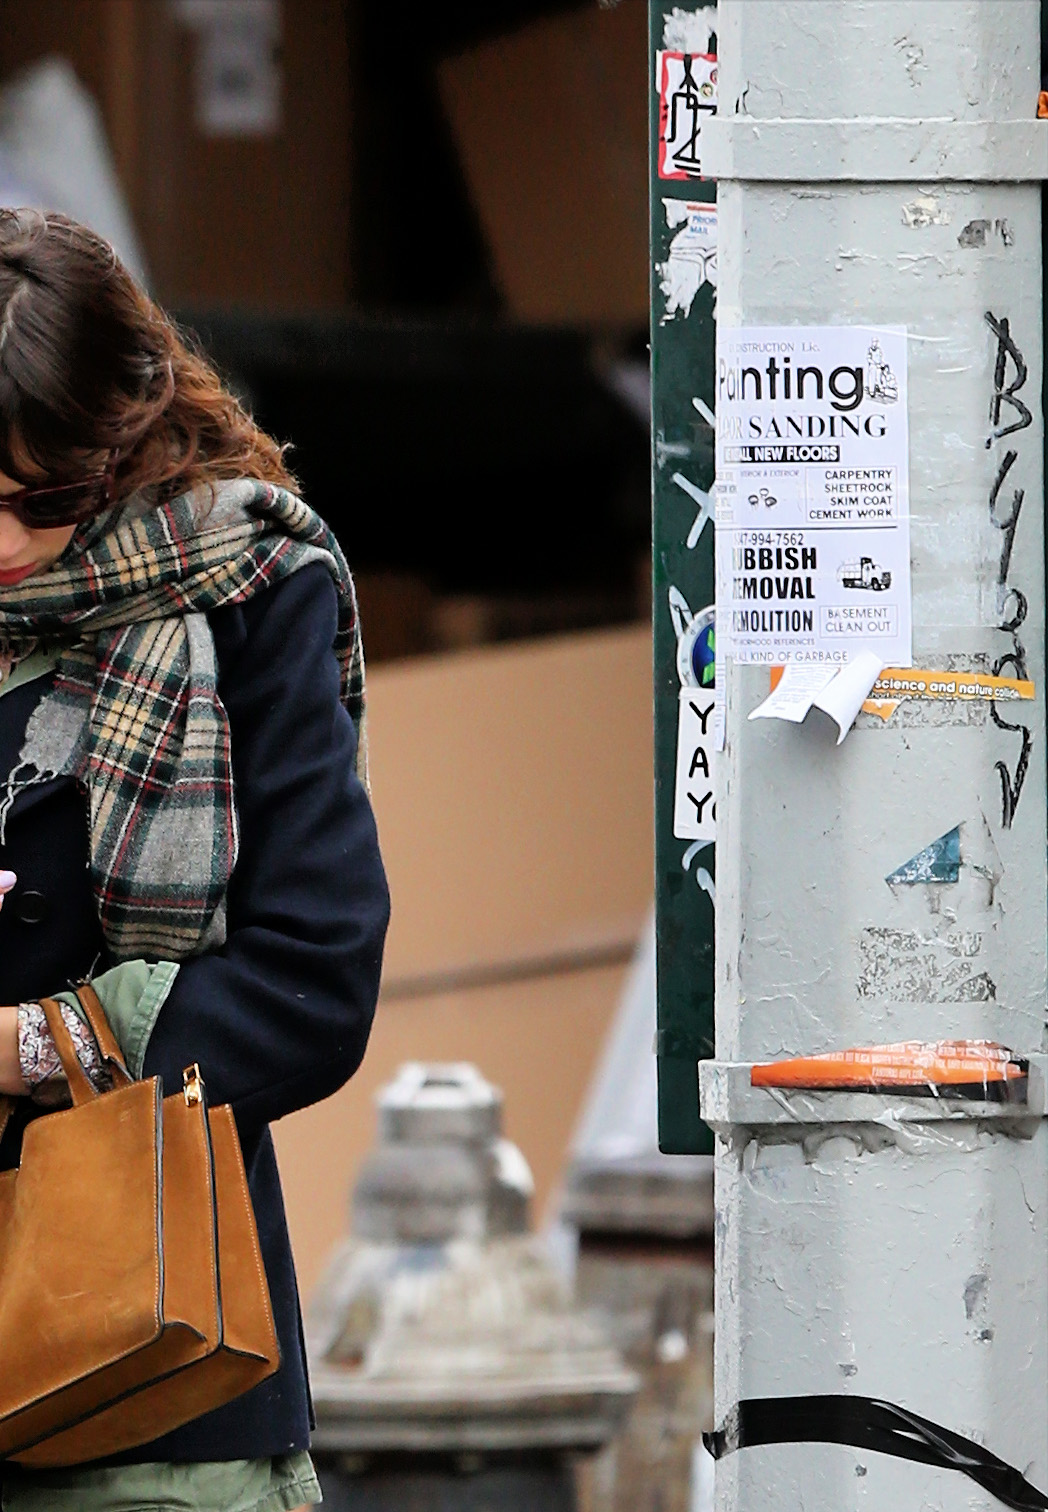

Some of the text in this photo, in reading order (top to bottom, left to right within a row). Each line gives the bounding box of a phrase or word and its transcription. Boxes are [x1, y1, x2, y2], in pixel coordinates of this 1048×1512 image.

[749, 413, 889, 440] SANDING
[754, 446, 784, 461] NEW
[787, 446, 838, 461] FLOORS
[824, 470, 892, 480] CARPENTRY
[824, 483, 892, 493] SHEETROCK
[830, 495, 892, 506] SKIM COAT
[809, 509, 892, 520] CEMENT WORK
[827, 608, 888, 620] BASEMENT
[825, 621, 891, 633] CLEAN OUT
[751, 651, 775, 662] KIND
[778, 651, 791, 662] OF
[795, 650, 848, 661] GARBAGE
[874, 678, 926, 691] science
[929, 681, 956, 693] and
[958, 683, 993, 696] nature
